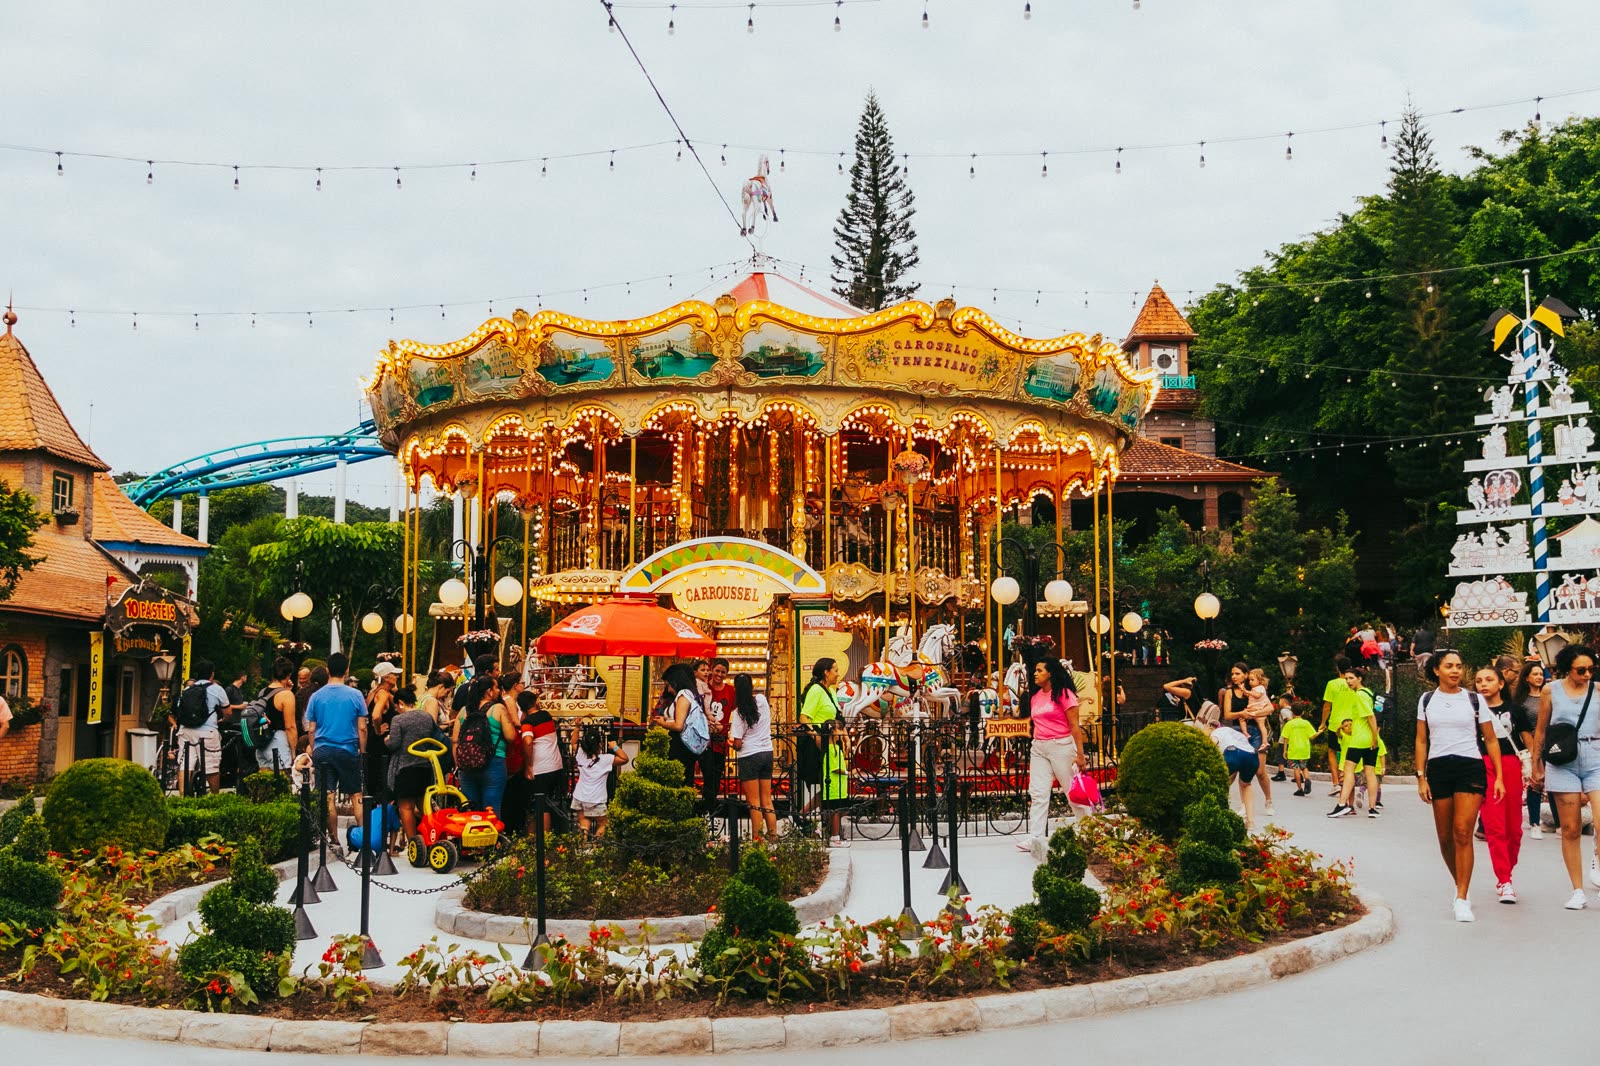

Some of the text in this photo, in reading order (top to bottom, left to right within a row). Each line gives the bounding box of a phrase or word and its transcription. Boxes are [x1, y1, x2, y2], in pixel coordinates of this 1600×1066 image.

[893, 340, 979, 358] CAROSELLO
[892, 356, 977, 375] VENEZIANO
[685, 585, 759, 602] CARROUSSEL
[124, 597, 176, 622] 10 PASTÉIS
[91, 653, 99, 718] CHOPP
[989, 722, 1028, 734] ENTRADA
